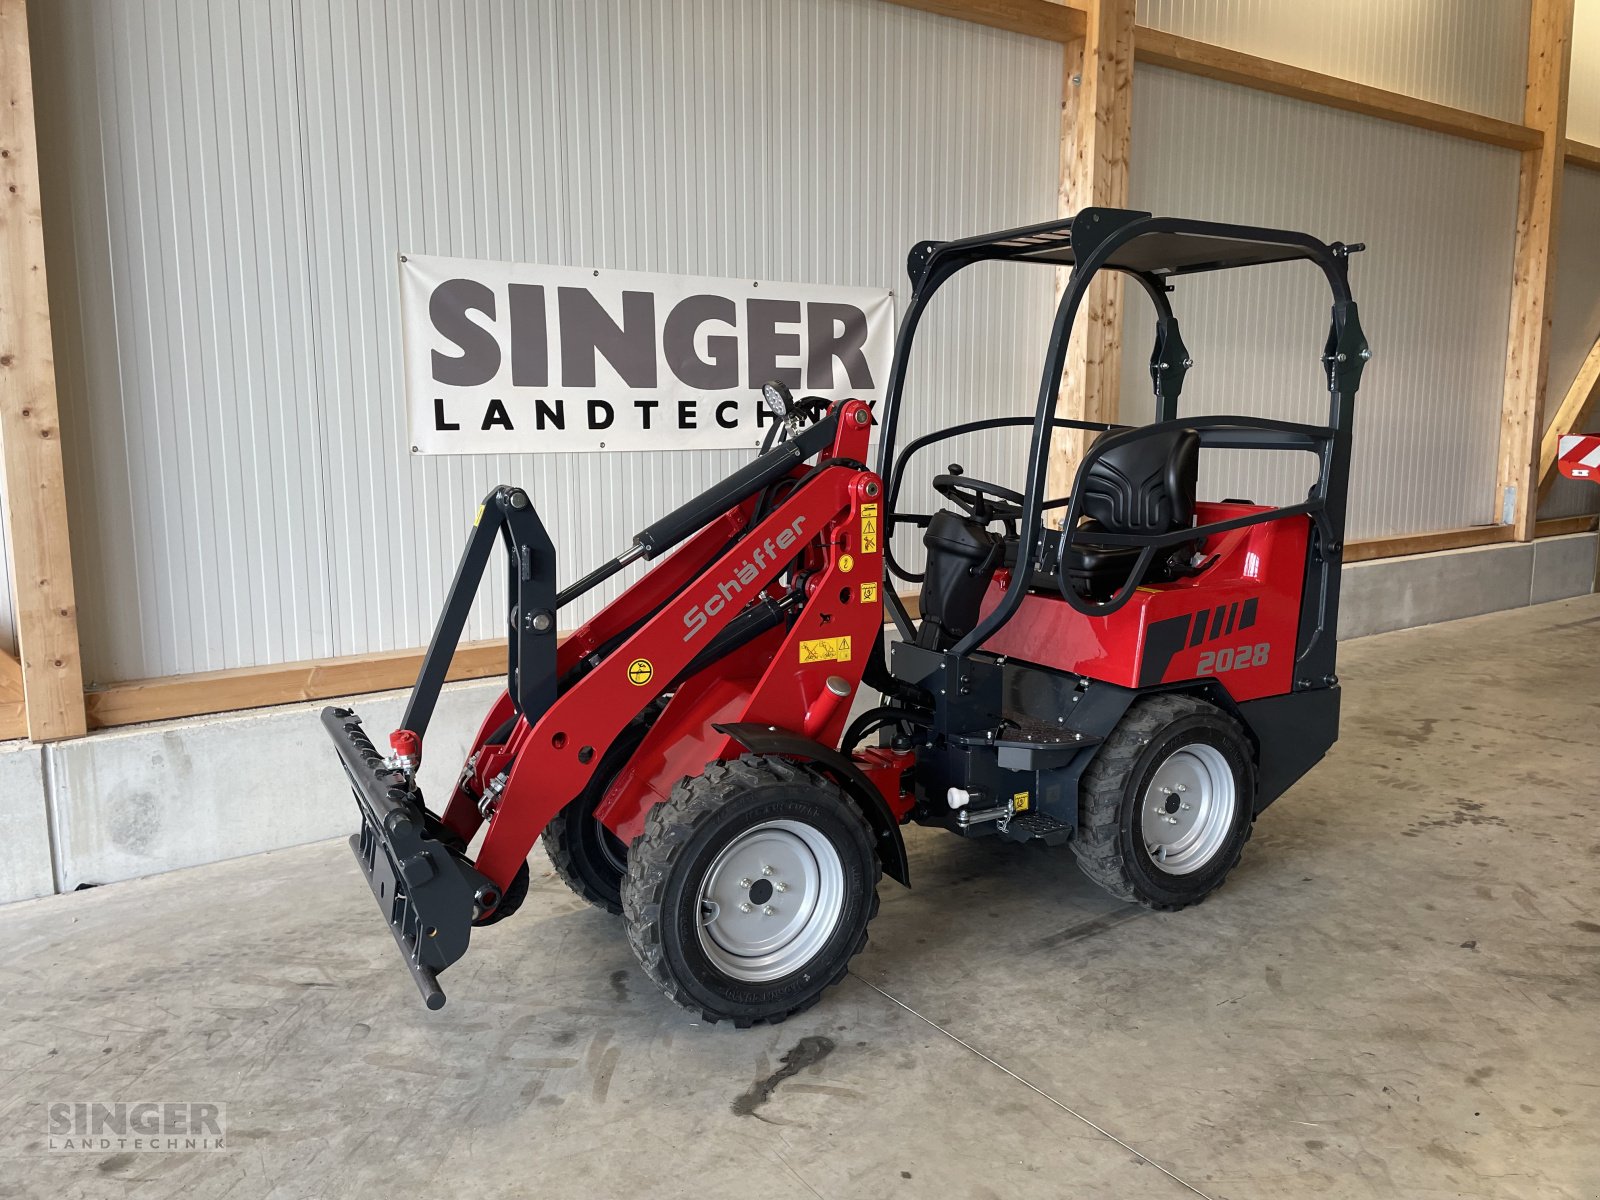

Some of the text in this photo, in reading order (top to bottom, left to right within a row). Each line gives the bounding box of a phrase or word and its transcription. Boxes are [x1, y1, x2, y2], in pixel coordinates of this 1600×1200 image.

[429, 278, 875, 391] SINGER
[434, 398, 879, 431] LANDTECHN
[683, 515, 807, 643] Schäffer
[1196, 642, 1271, 677] 2028
